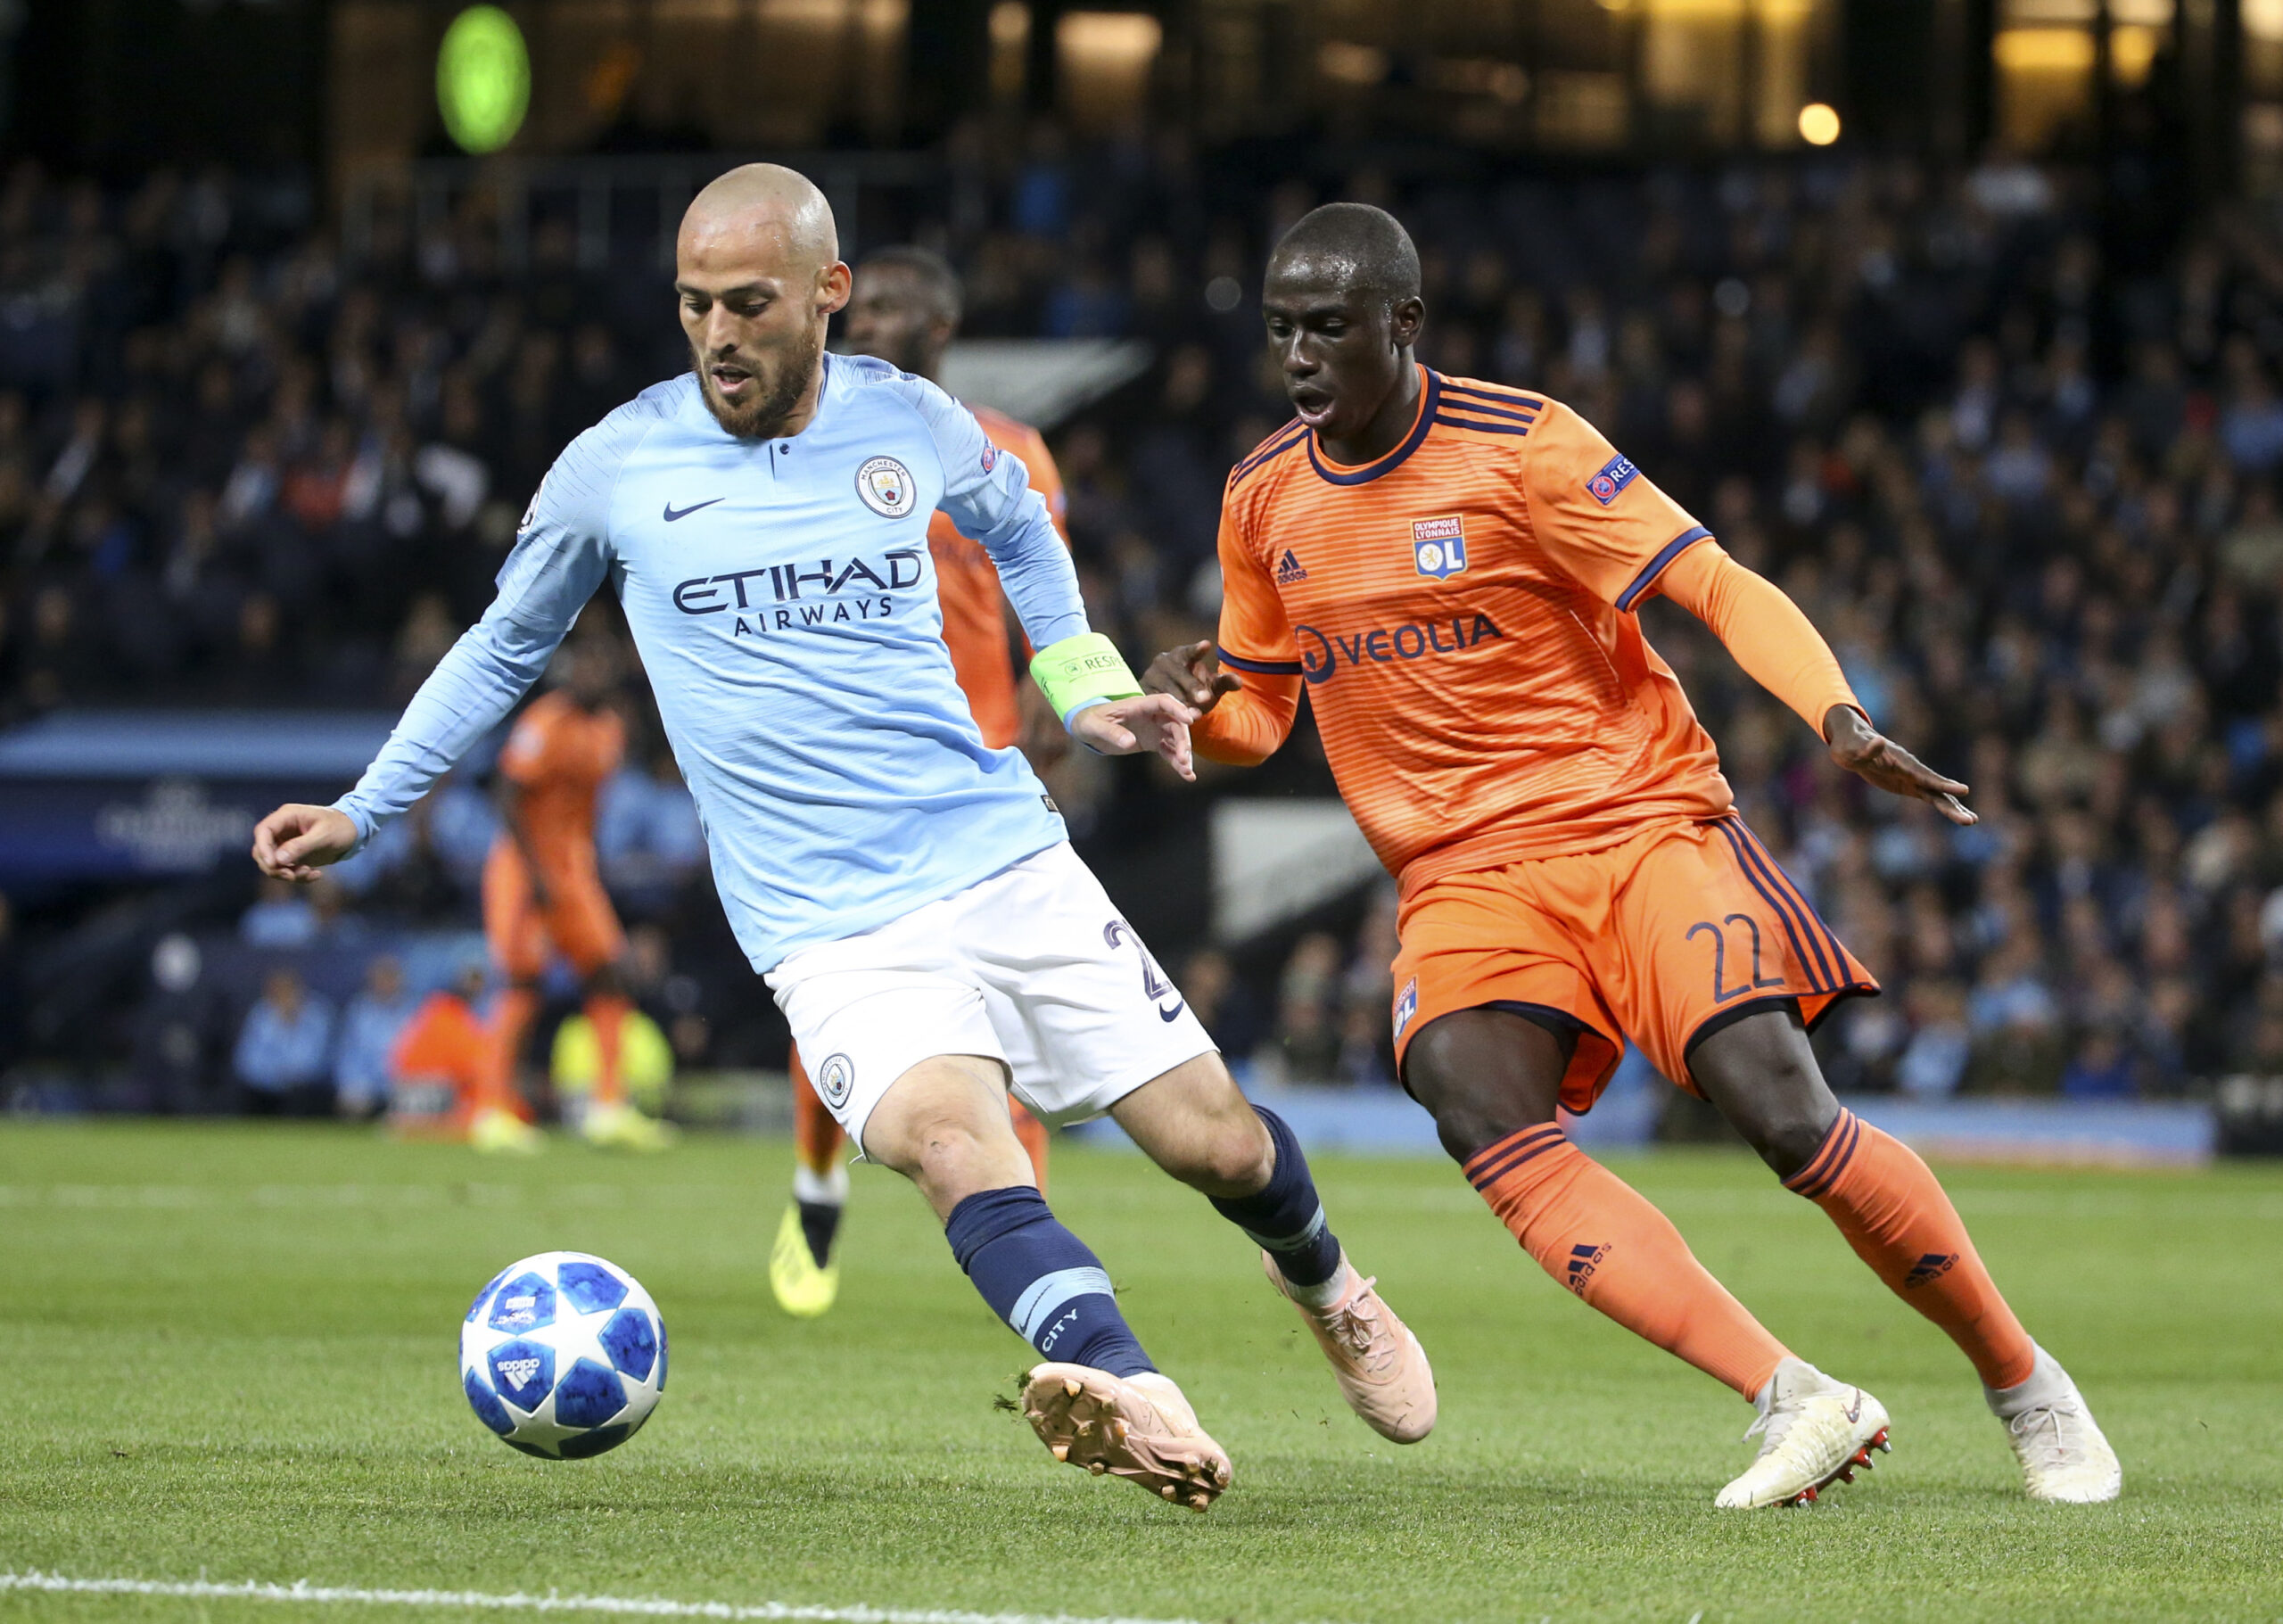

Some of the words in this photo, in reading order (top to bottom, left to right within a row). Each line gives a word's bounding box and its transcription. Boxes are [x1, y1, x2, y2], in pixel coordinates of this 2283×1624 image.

[861, 461, 906, 481] MANCHESTER
[1609, 458, 1635, 482] RES
[1414, 518, 1459, 531] OLYMPIQUE
[1415, 527, 1460, 540] LYONNAIS
[1418, 540, 1463, 572] OL
[672, 550, 922, 615] ETIHAD
[734, 597, 893, 637] AIRWAYS
[1335, 614, 1504, 665] VEOLIA
[1685, 913, 1785, 1004] 22
[1575, 1242, 1612, 1296] adidas
[1042, 1308, 1077, 1352] CITY
[497, 1357, 540, 1373] adidas
